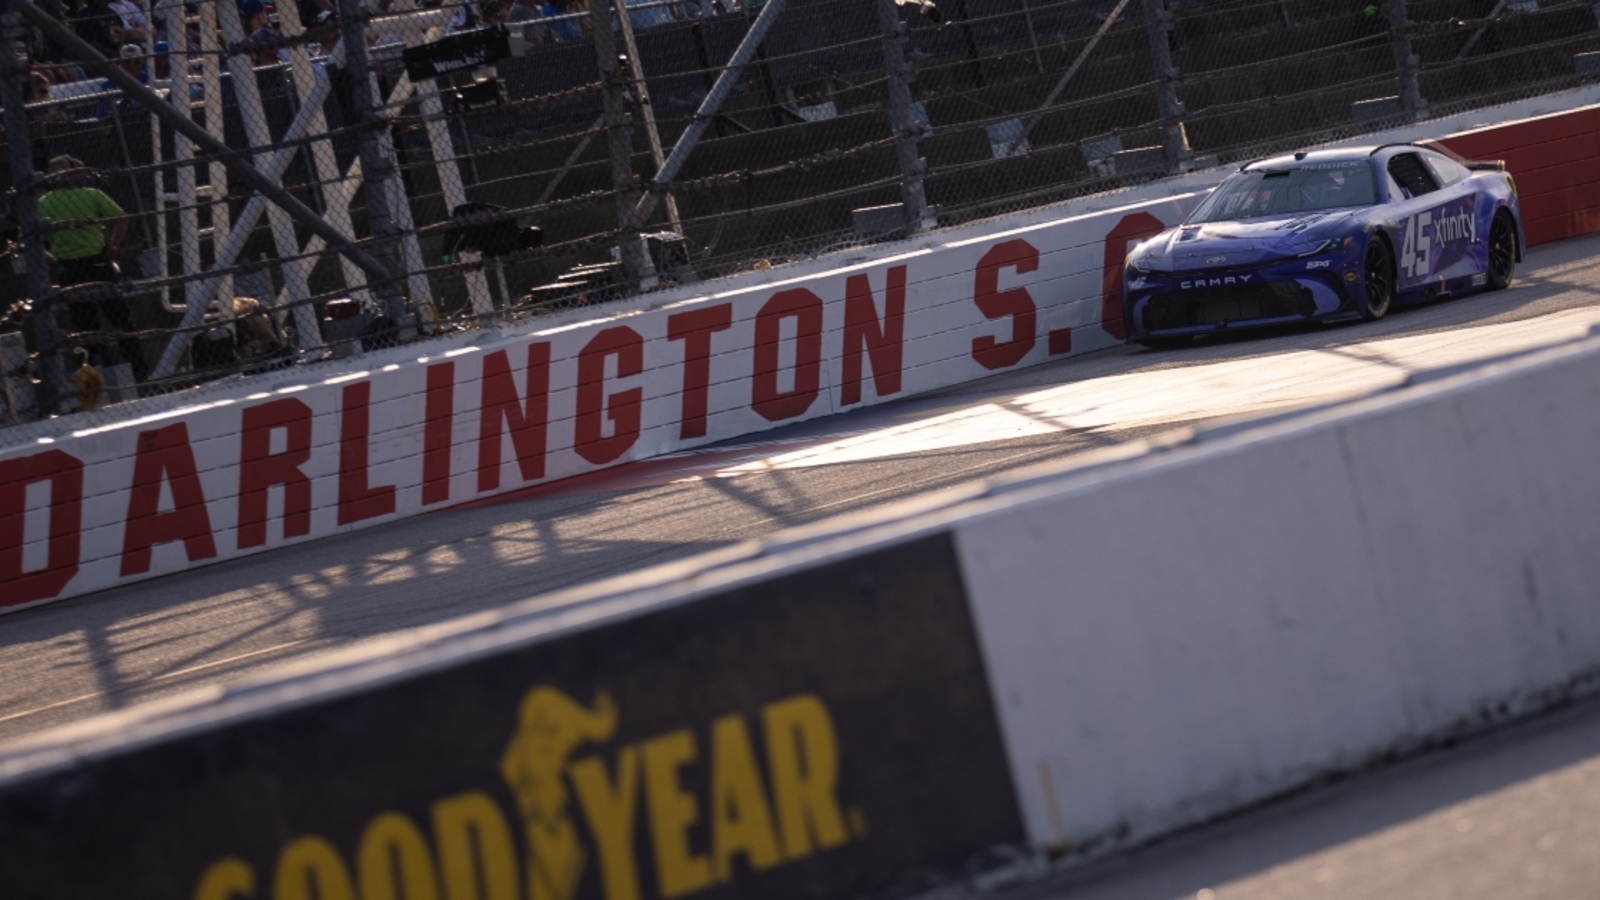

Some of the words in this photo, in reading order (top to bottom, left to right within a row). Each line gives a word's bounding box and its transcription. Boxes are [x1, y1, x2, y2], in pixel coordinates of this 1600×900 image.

[433, 50, 486, 73] WHELEN
[1401, 211, 1432, 278] 45
[1434, 206, 1475, 249] xfinity
[1180, 274, 1252, 289] CAMRY
[0, 264, 907, 604] DARLINGTON
